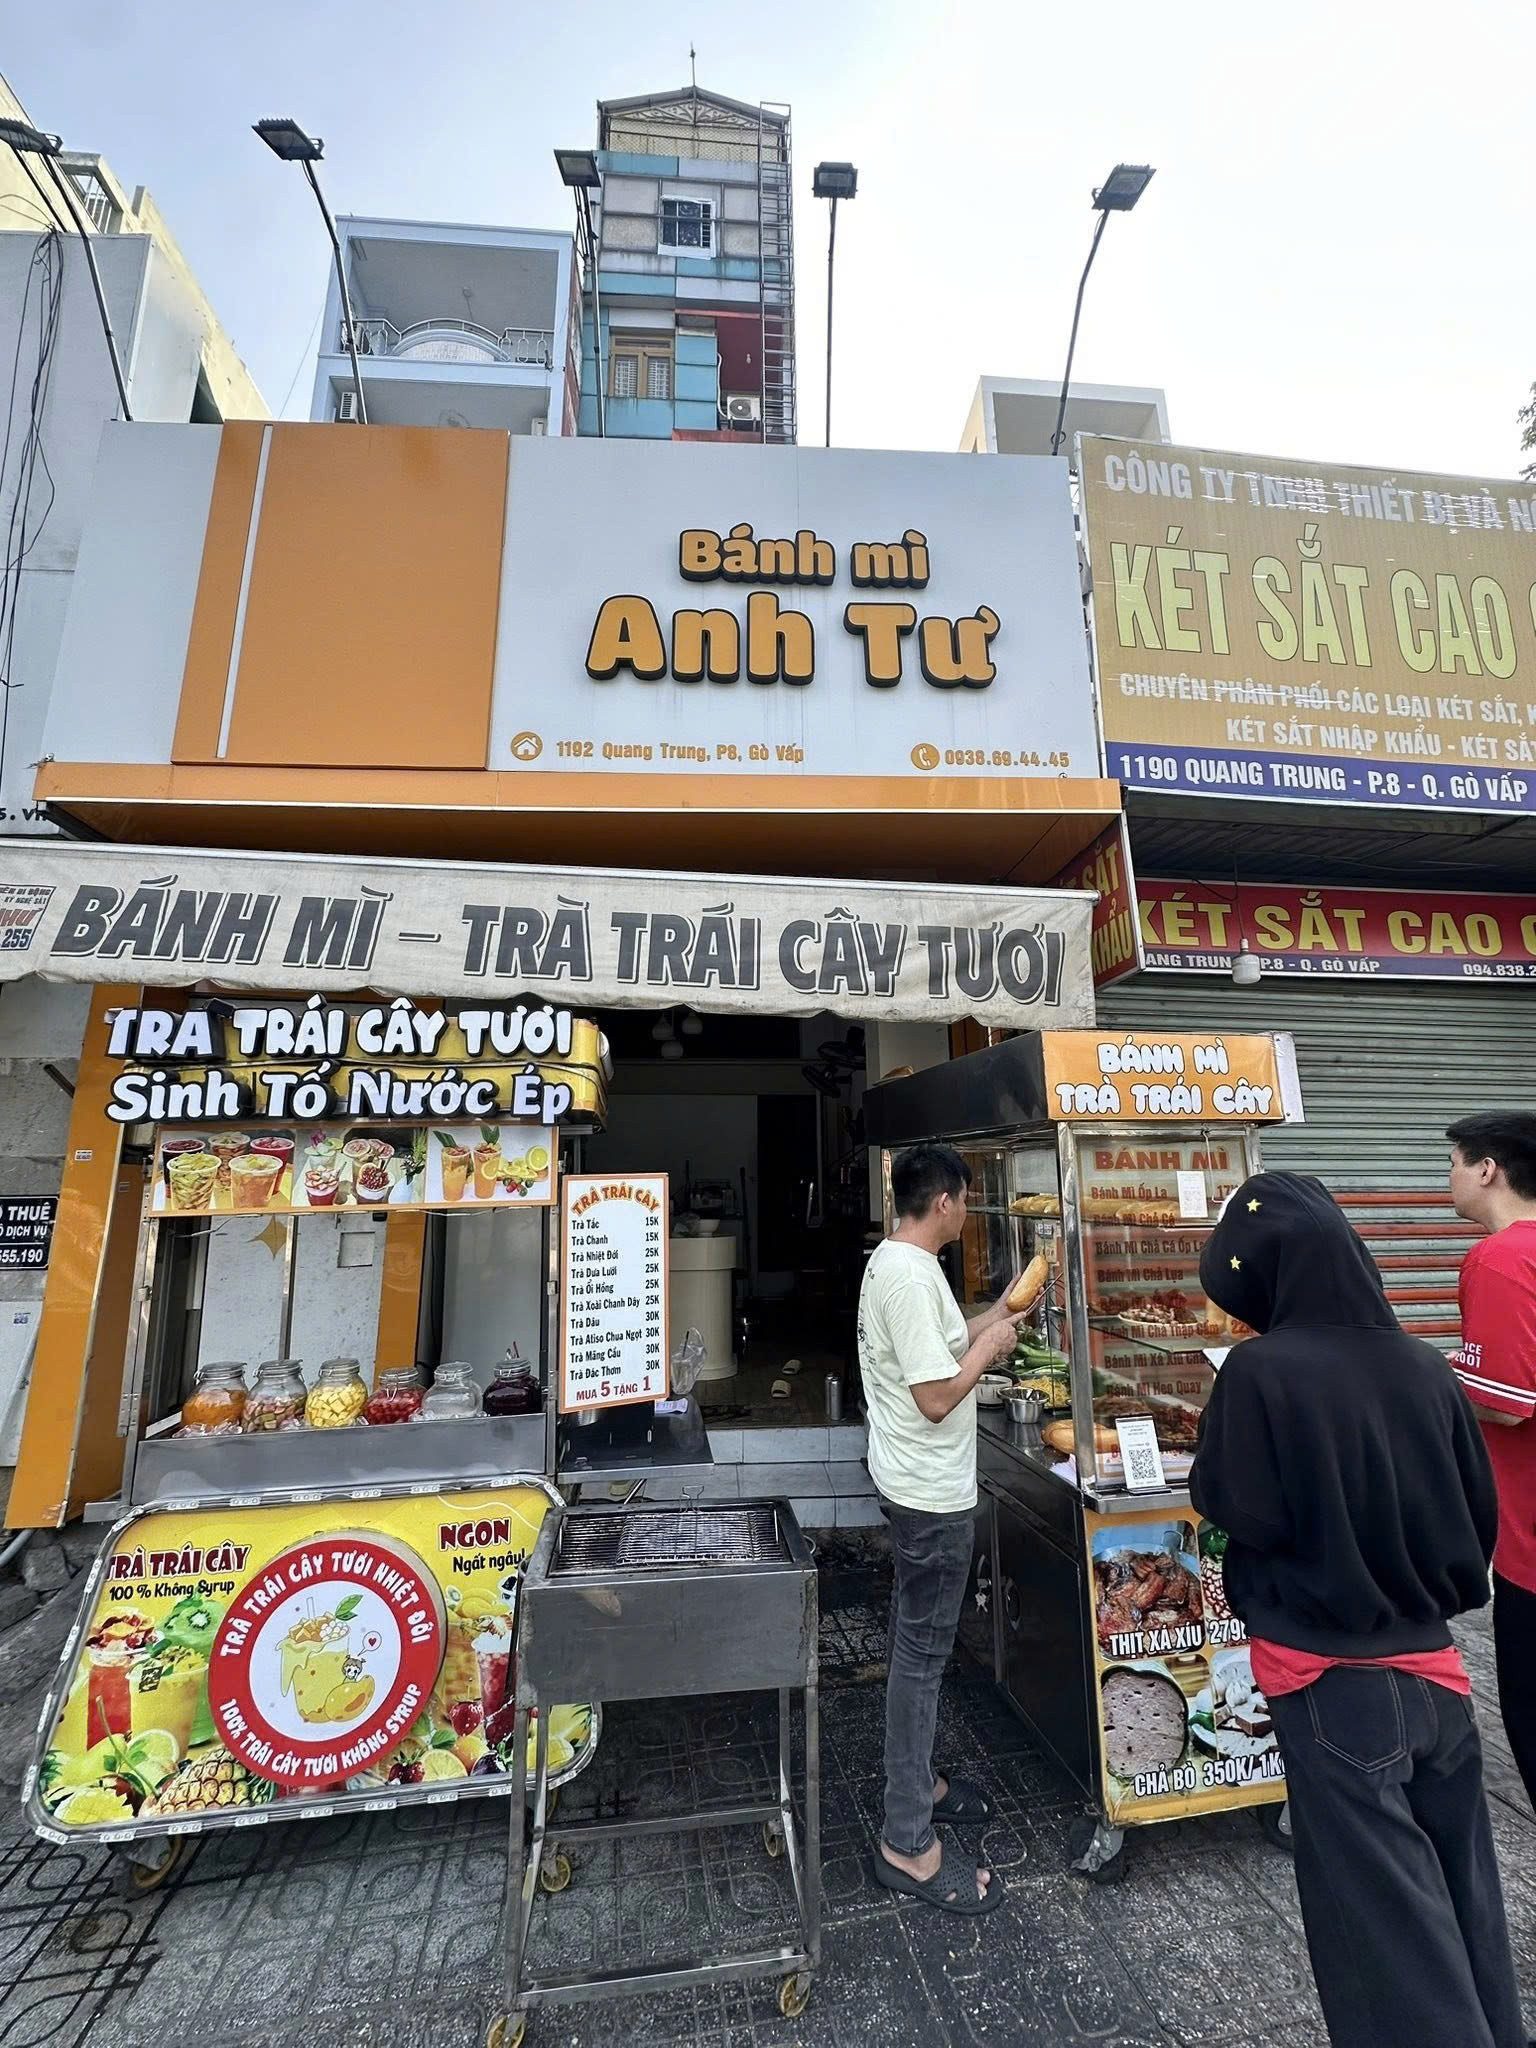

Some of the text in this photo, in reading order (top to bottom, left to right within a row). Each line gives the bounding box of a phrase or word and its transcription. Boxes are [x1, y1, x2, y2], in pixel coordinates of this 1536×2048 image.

[1104, 450, 1415, 522] CÔNG TY THIẾT
[679, 522, 931, 589] Bánh mì
[1110, 525, 1231, 655] KÉT
[1252, 522, 1373, 667] SẮT
[1389, 569, 1517, 679] CAO
[585, 591, 1001, 690] Anh Tư
[1119, 673, 1208, 701] CHUYÊN
[1214, 677, 1274, 706] PHÂN
[1336, 687, 1379, 714] CÁC
[1384, 693, 1432, 722] LOẠI
[1437, 694, 1473, 720] KÉT
[1226, 715, 1499, 760] KÉT SẮT NHẬP KHẨU KÉT
[556, 741, 804, 763] 1192 Quang Trung, P8, Gò Vấp
[945, 749, 1070, 768] 0938.69.44.45
[1120, 755, 1528, 802] 1190 QUANG TRUNG P.8 Q. GÒ VẤP
[1137, 894, 1232, 947] KÉT
[1253, 891, 1366, 952] SẮT
[1387, 910, 1502, 956] CAO
[1, 928, 33, 948] 255
[50, 873, 1065, 1007] BÁNH MÌ TRÀ TRÁI CÂY TƯƠI
[1321, 957, 1344, 972] GÒ
[1348, 956, 1381, 973] VẤP
[233, 992, 573, 1058] TRÁI CÂY TƯƠI
[1097, 1035, 1229, 1075] BÁNH MÌ
[105, 1060, 574, 1125] Sinh Tố Nước Ép
[1055, 1074, 1273, 1114] TRÀ TRÁI CÂY
[1095, 1147, 1229, 1171] BÁNH MÌ
[570, 1186, 602, 1217] TRÀ
[601, 1181, 633, 1200] TRÁI
[1091, 1185, 1118, 1200] Bánh
[1155, 1186, 1168, 1200] La
[8, 1202, 51, 1221] THUÊ
[572, 1220, 584, 1230] Trà
[645, 1217, 659, 1226] 15K
[6, 1225, 31, 1240] DỊCH
[34, 1225, 48, 1239] VỤ
[571, 1232, 659, 1246] Trà Chanh 15K
[571, 1252, 584, 1262] Trà
[645, 1247, 659, 1257] 25K
[571, 1269, 584, 1278] Trà
[645, 1263, 659, 1273] 25K
[571, 1279, 659, 1295] Trà 25K
[570, 1302, 584, 1312] Trà
[603, 1298, 625, 1309] Chanh
[645, 1295, 659, 1305] 25K
[570, 1319, 584, 1329] Trà
[645, 1311, 660, 1321] 30K
[570, 1336, 583, 1346] Trà
[606, 1331, 624, 1342] Chua
[645, 1327, 660, 1337] 30K
[570, 1353, 583, 1363] Trà
[645, 1343, 660, 1354] 30K
[570, 1370, 583, 1380] Trà
[645, 1360, 660, 1370] 30K
[576, 1389, 597, 1401] MUA
[601, 1381, 611, 1397] 5
[643, 1375, 651, 1391] 1
[439, 1517, 511, 1551] NGON
[106, 1538, 251, 1580] TRÀ TRÁI CÂY
[453, 1553, 486, 1576] Ngất
[109, 1585, 134, 1601] 100
[154, 1582, 194, 1598] Không
[197, 1579, 235, 1597] Syrup
[220, 1617, 253, 1657] TRÀ
[243, 1573, 287, 1616] TRÁI
[288, 1553, 324, 1583] CÂY
[373, 1561, 420, 1609] NHIỆT
[1109, 1623, 1202, 1659] THỊT XÁ XÍU
[219, 1683, 423, 1777] 100% TRÁI CÂY TƯƠI KHÔNG SYRUP
[1133, 1763, 1169, 1797] CHẢ
[1172, 1761, 1196, 1791] BÒ
